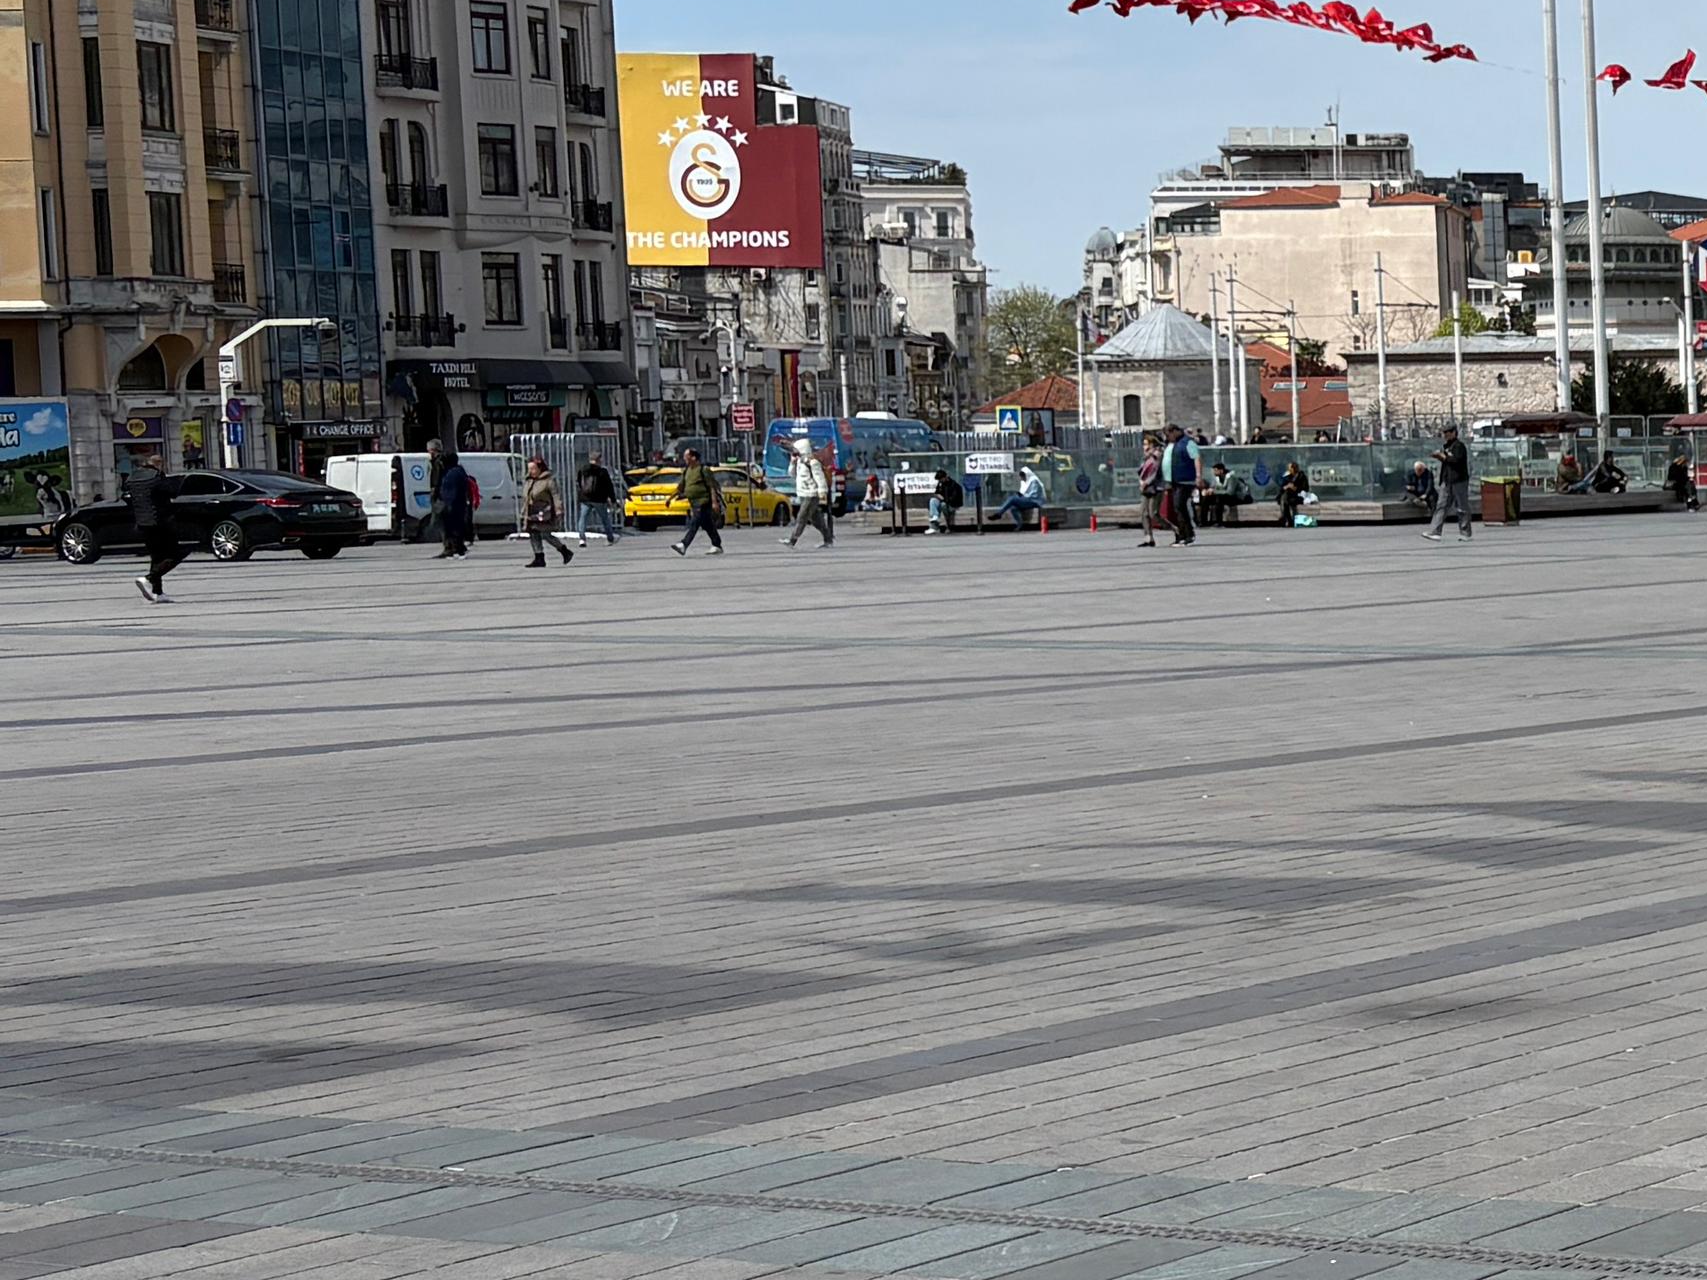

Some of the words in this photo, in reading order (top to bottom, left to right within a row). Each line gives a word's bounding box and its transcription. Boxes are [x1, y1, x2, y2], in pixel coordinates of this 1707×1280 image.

[662, 80, 693, 97] WE
[700, 80, 739, 97] ARE
[627, 231, 665, 248] THE
[671, 231, 790, 248] CHAMPIONS
[444, 377, 471, 387] HOTEL
